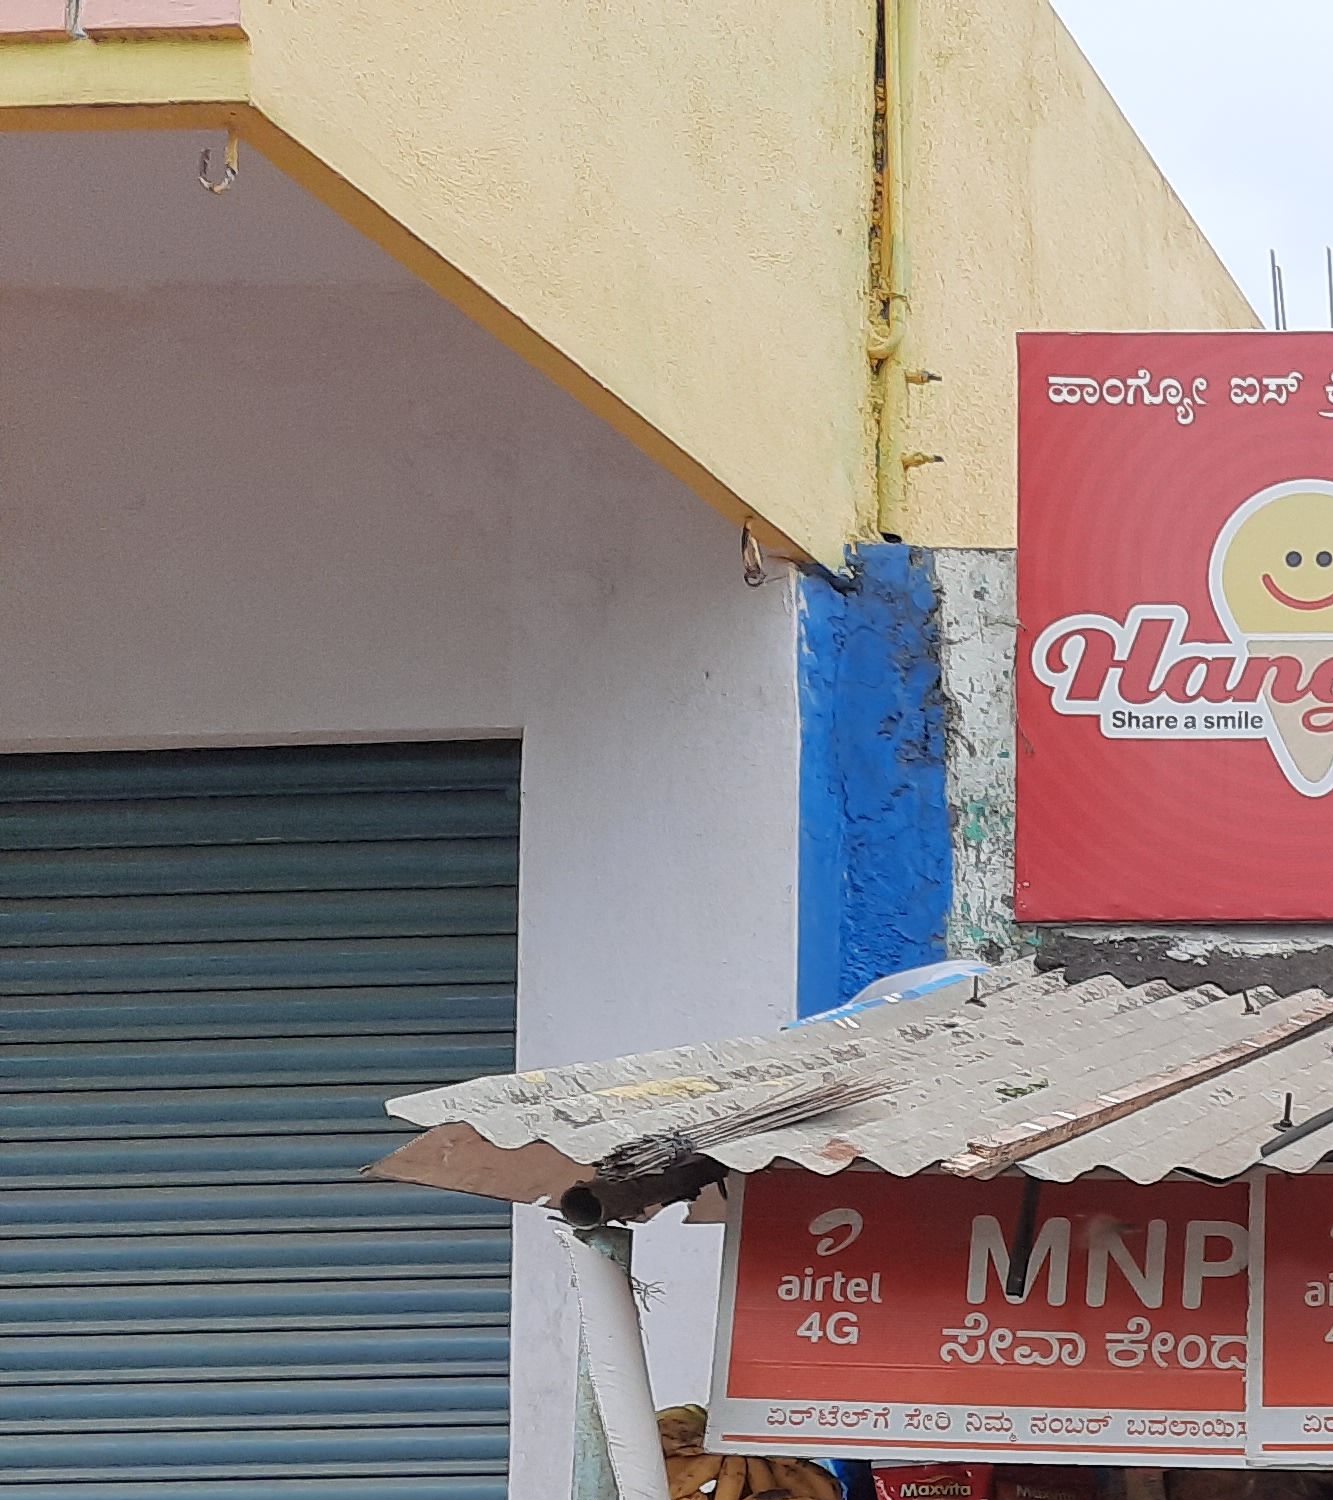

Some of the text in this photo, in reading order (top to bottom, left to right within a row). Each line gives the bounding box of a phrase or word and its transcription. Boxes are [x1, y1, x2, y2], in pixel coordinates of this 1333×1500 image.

[1047, 369, 1209, 424] ಹಾಂಗ್ಯೋ
[1229, 371, 1303, 405] ಐಸ್
[1112, 711, 1263, 730] Share a smile
[965, 1215, 1249, 1310] MNP
[777, 1267, 883, 1304] airtel
[796, 1311, 860, 1345] 4G
[939, 1312, 1247, 1372] ಸೇವಾ ಕೇಂದ
[904, 1406, 953, 1432] ಸೇರಿ
[965, 1410, 1019, 1442] ನಿಮ್ಮ
[1030, 1413, 1112, 1436] ನಂಬರ್
[900, 1481, 972, 1498] Maxvita
